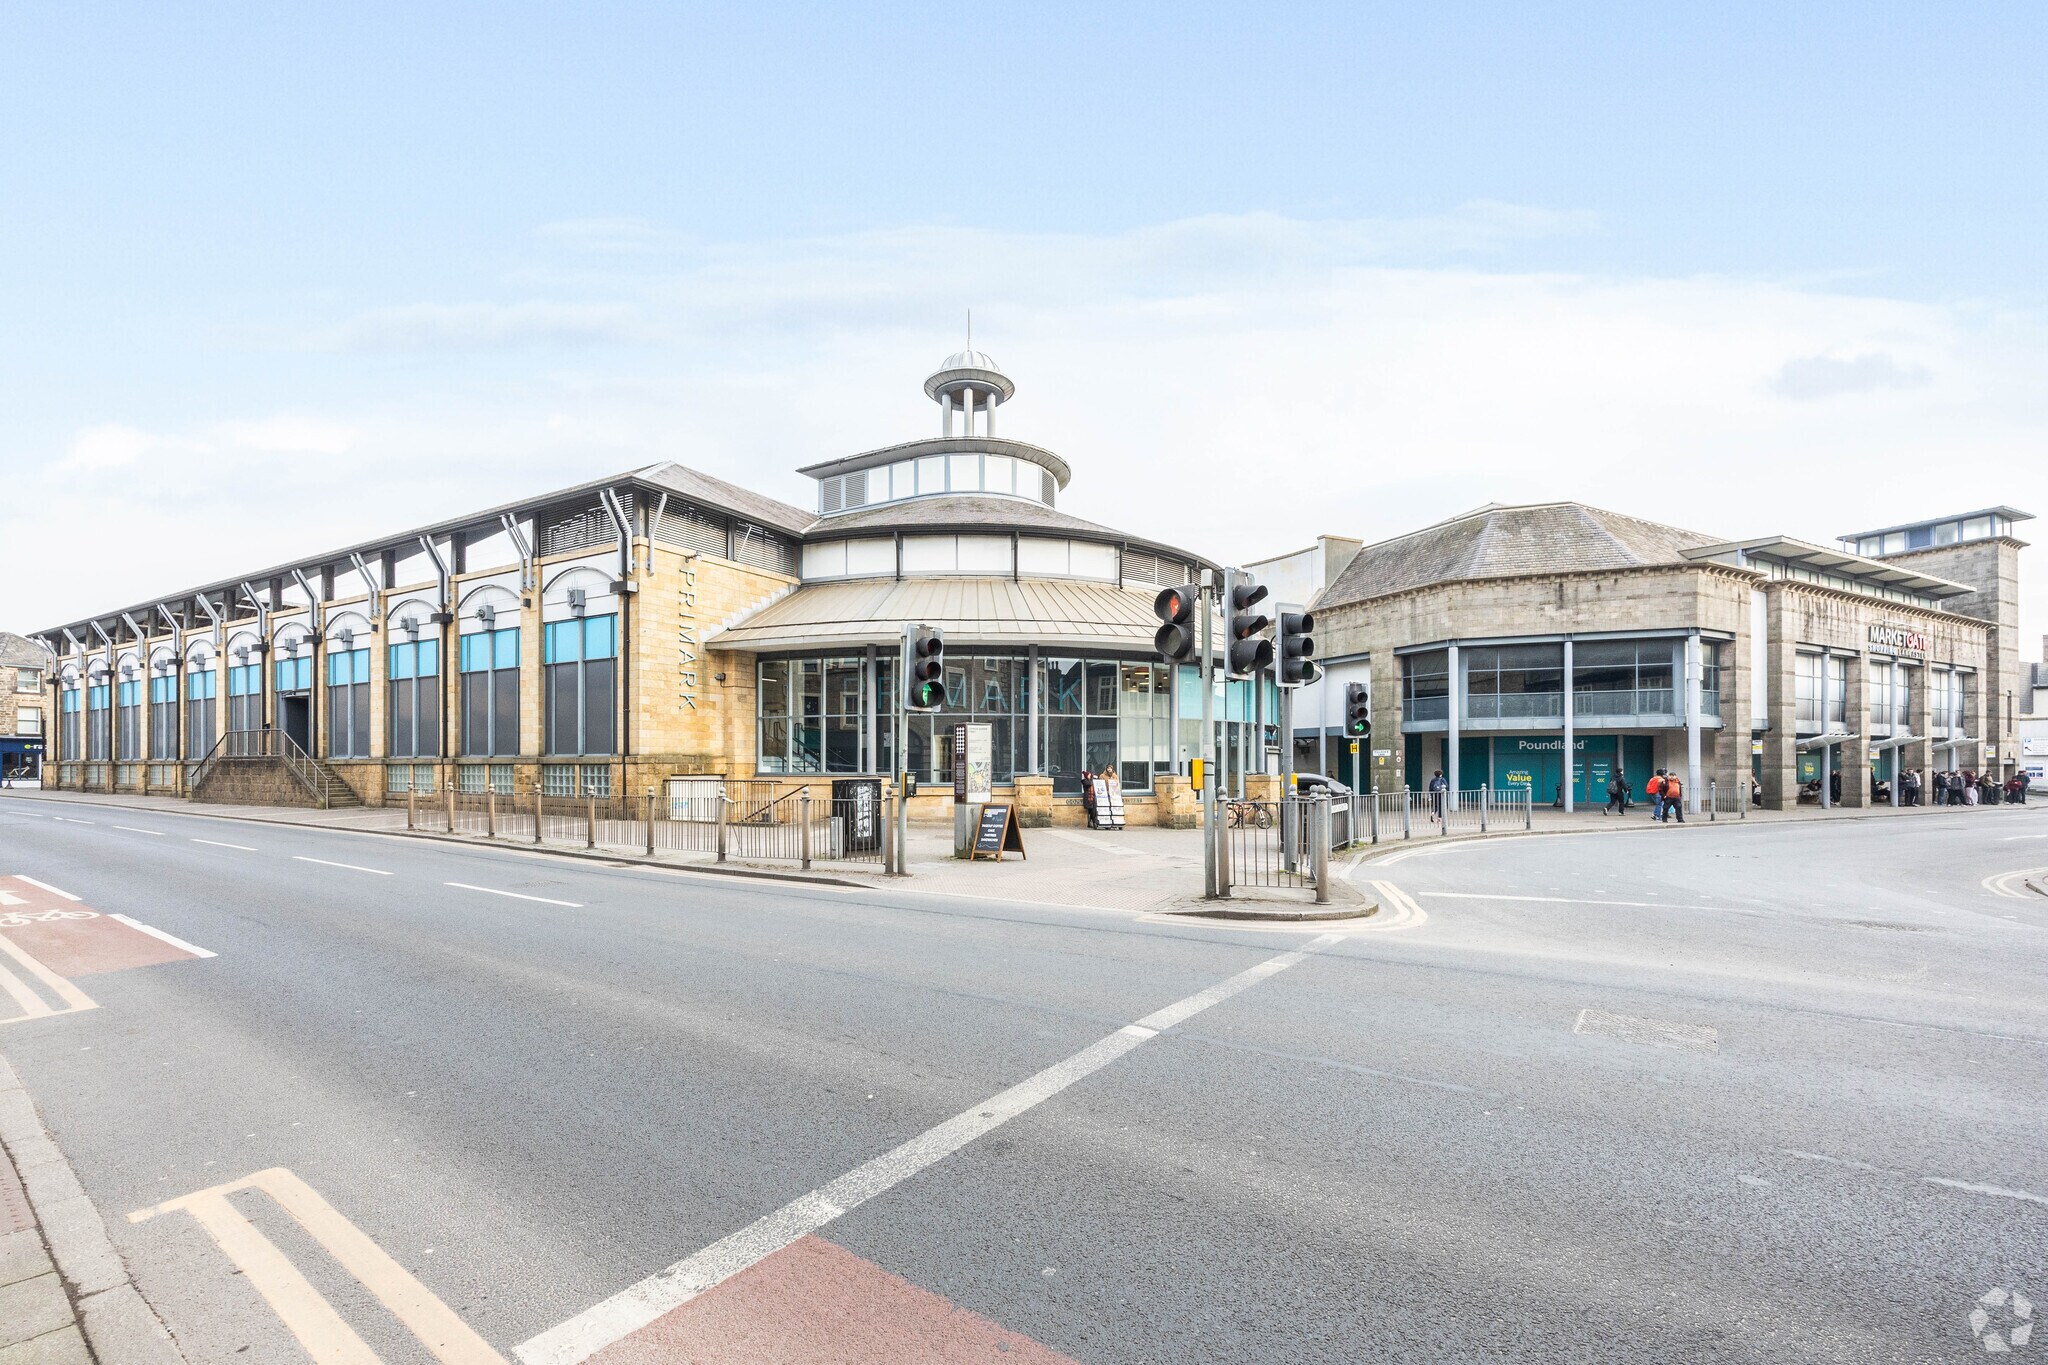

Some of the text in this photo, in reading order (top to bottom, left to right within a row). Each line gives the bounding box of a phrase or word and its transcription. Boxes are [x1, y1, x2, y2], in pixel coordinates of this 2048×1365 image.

[679, 569, 697, 710] PRIMARK
[843, 676, 1082, 711] PRMARK
[1506, 774, 1532, 782] Value
